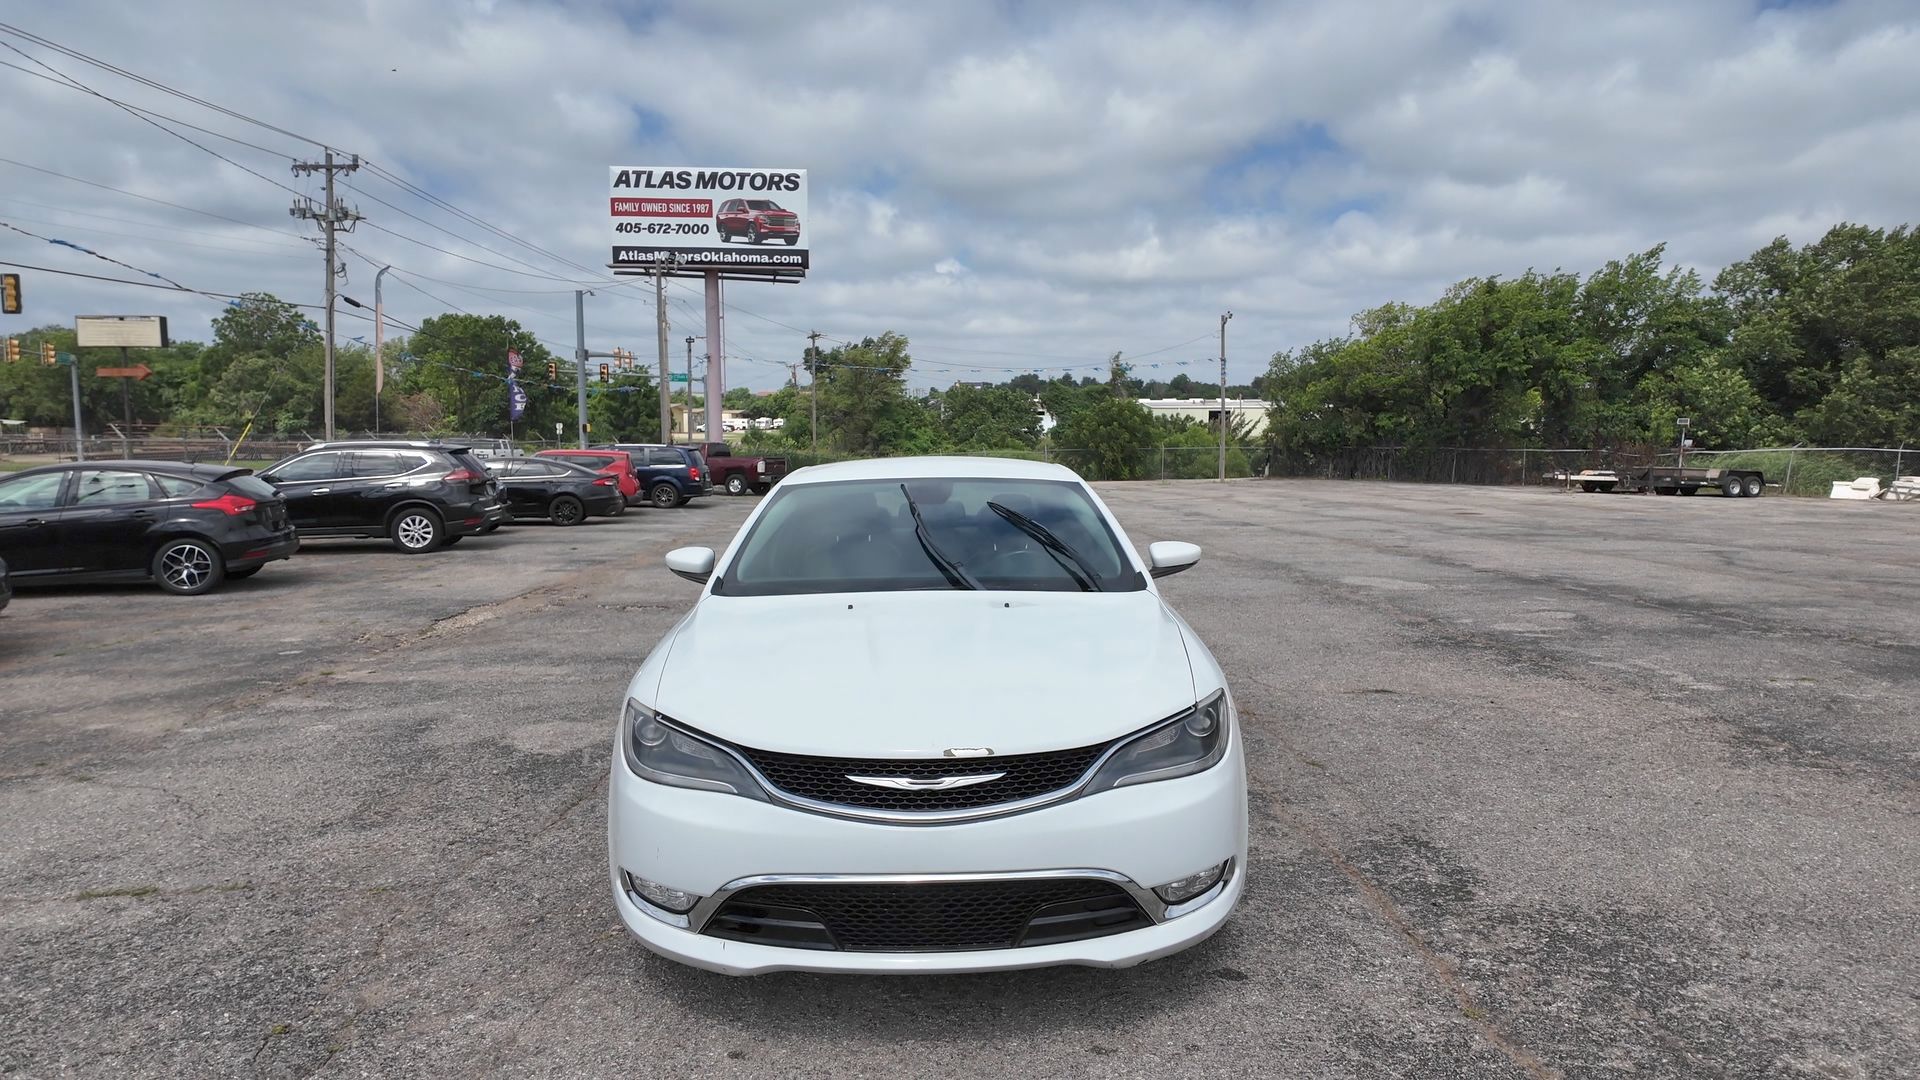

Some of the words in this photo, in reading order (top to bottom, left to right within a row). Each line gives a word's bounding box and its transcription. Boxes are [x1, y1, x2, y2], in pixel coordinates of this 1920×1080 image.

[613, 170, 692, 189] ATLAS
[695, 172, 800, 192] MOTORS
[614, 202, 639, 212] FAMILY
[641, 202, 667, 213] OWNED
[669, 203, 690, 214] SINCE
[692, 203, 709, 214] 1987
[615, 222, 709, 235] 405-672-7000
